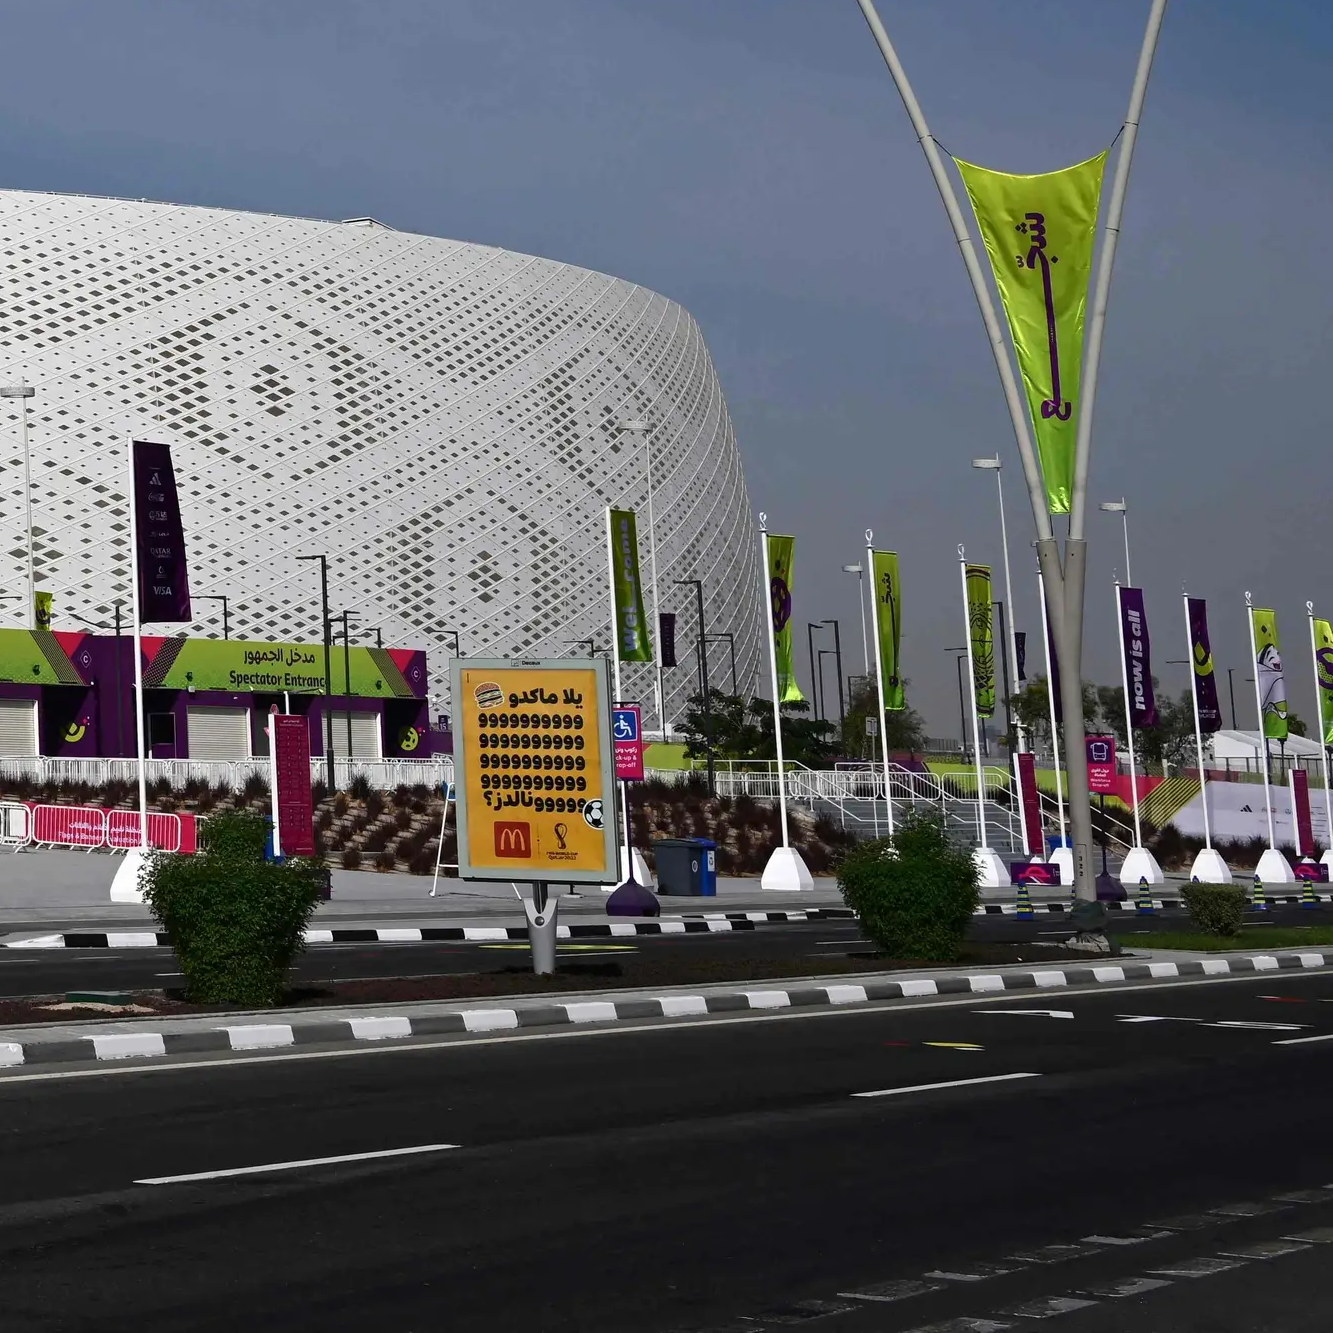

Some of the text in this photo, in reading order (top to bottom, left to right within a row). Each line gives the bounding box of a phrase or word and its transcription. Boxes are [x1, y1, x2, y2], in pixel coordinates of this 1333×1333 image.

[153, 586, 172, 596] VISA
[83, 655, 89, 664] C
[244, 647, 316, 667] مدخل الجمهور
[1127, 609, 1146, 711] now is all
[229, 669, 326, 687] Spectator Entranc
[413, 670, 419, 678] C
[508, 687, 583, 709] يلا ماكدو
[615, 754, 632, 762] ck-up
[110, 836, 137, 844] valuation
